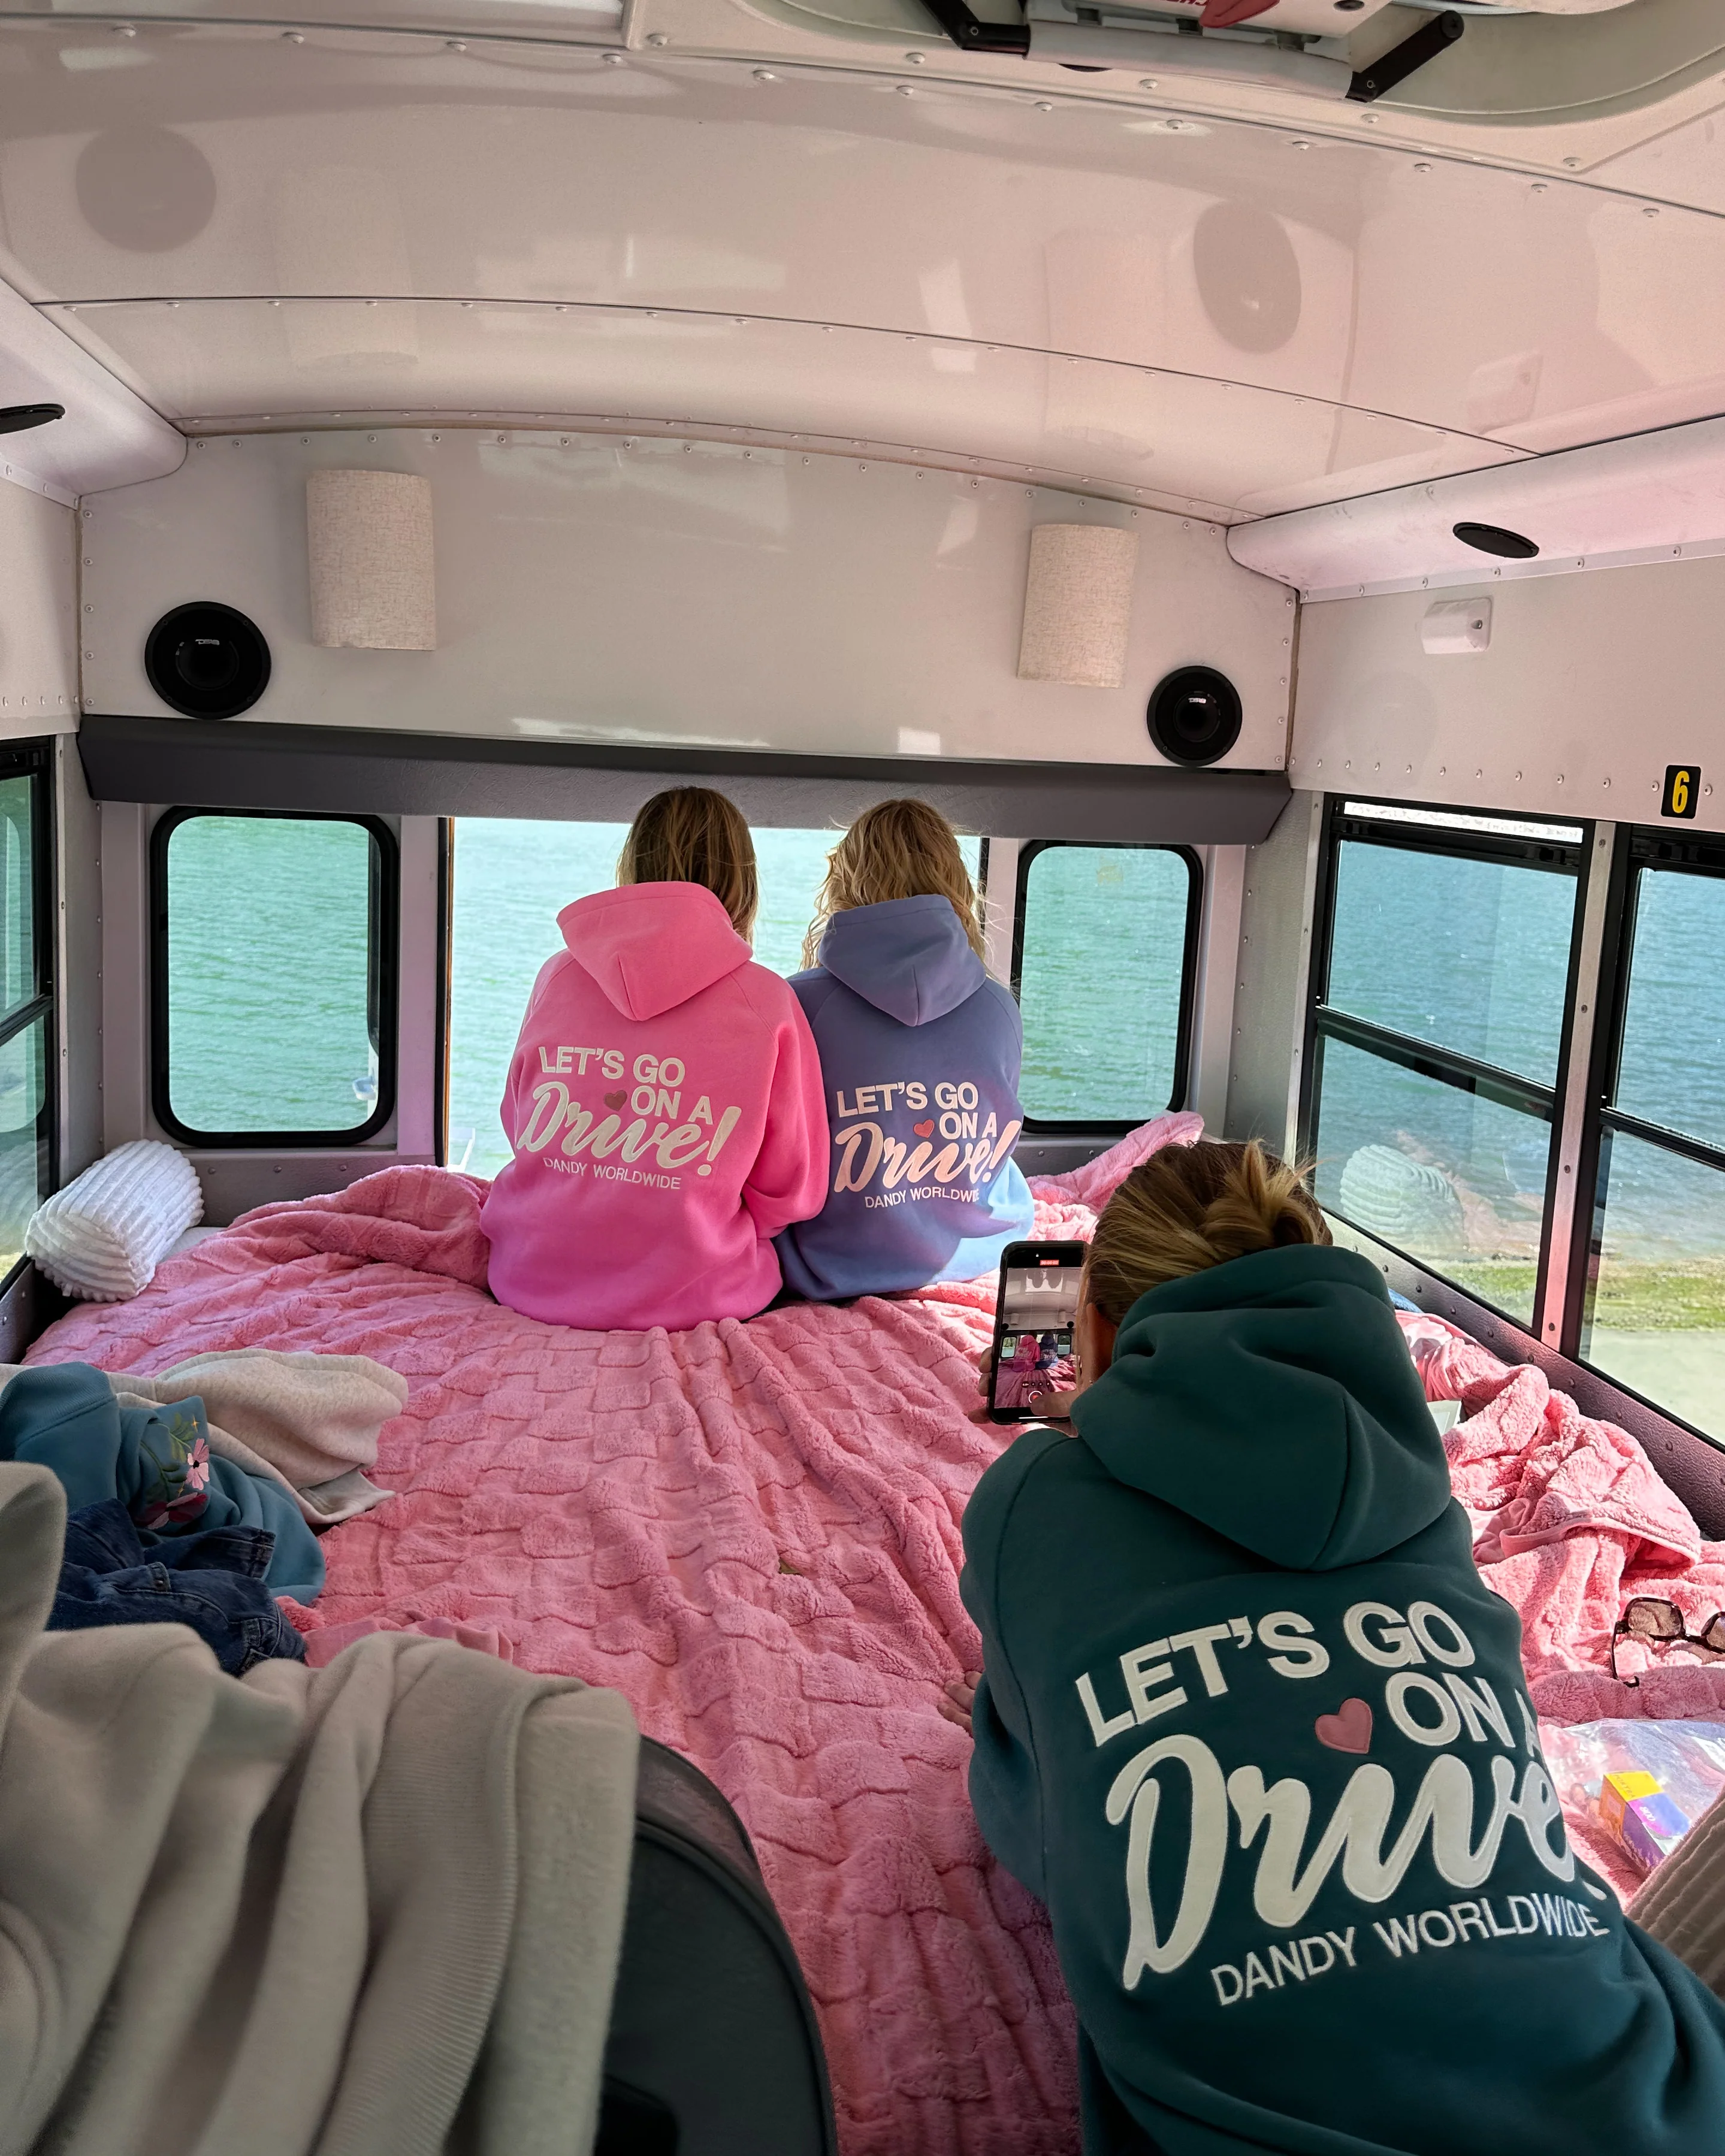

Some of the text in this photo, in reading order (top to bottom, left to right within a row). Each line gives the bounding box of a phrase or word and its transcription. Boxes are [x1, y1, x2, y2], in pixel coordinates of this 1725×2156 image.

[1672, 770, 1690, 814] 6
[539, 1046, 685, 1087] LET'S GO
[631, 1085, 714, 1126] ON A
[836, 1081, 978, 1118] LET'S GO
[516, 1081, 742, 1176] Drive!
[939, 1111, 998, 1139] ON A
[542, 1157, 682, 1190] DANDY WORLDWIDE
[834, 1120, 1022, 1193] Drive!
[865, 1190, 907, 1209] DANDY
[1075, 1601, 1475, 1747] LET'S GO
[1385, 1671, 1544, 1758] ON A
[1639, 1806, 1656, 1822] 800
[1210, 1892, 1611, 2007] DANDY WORLDWIDE
